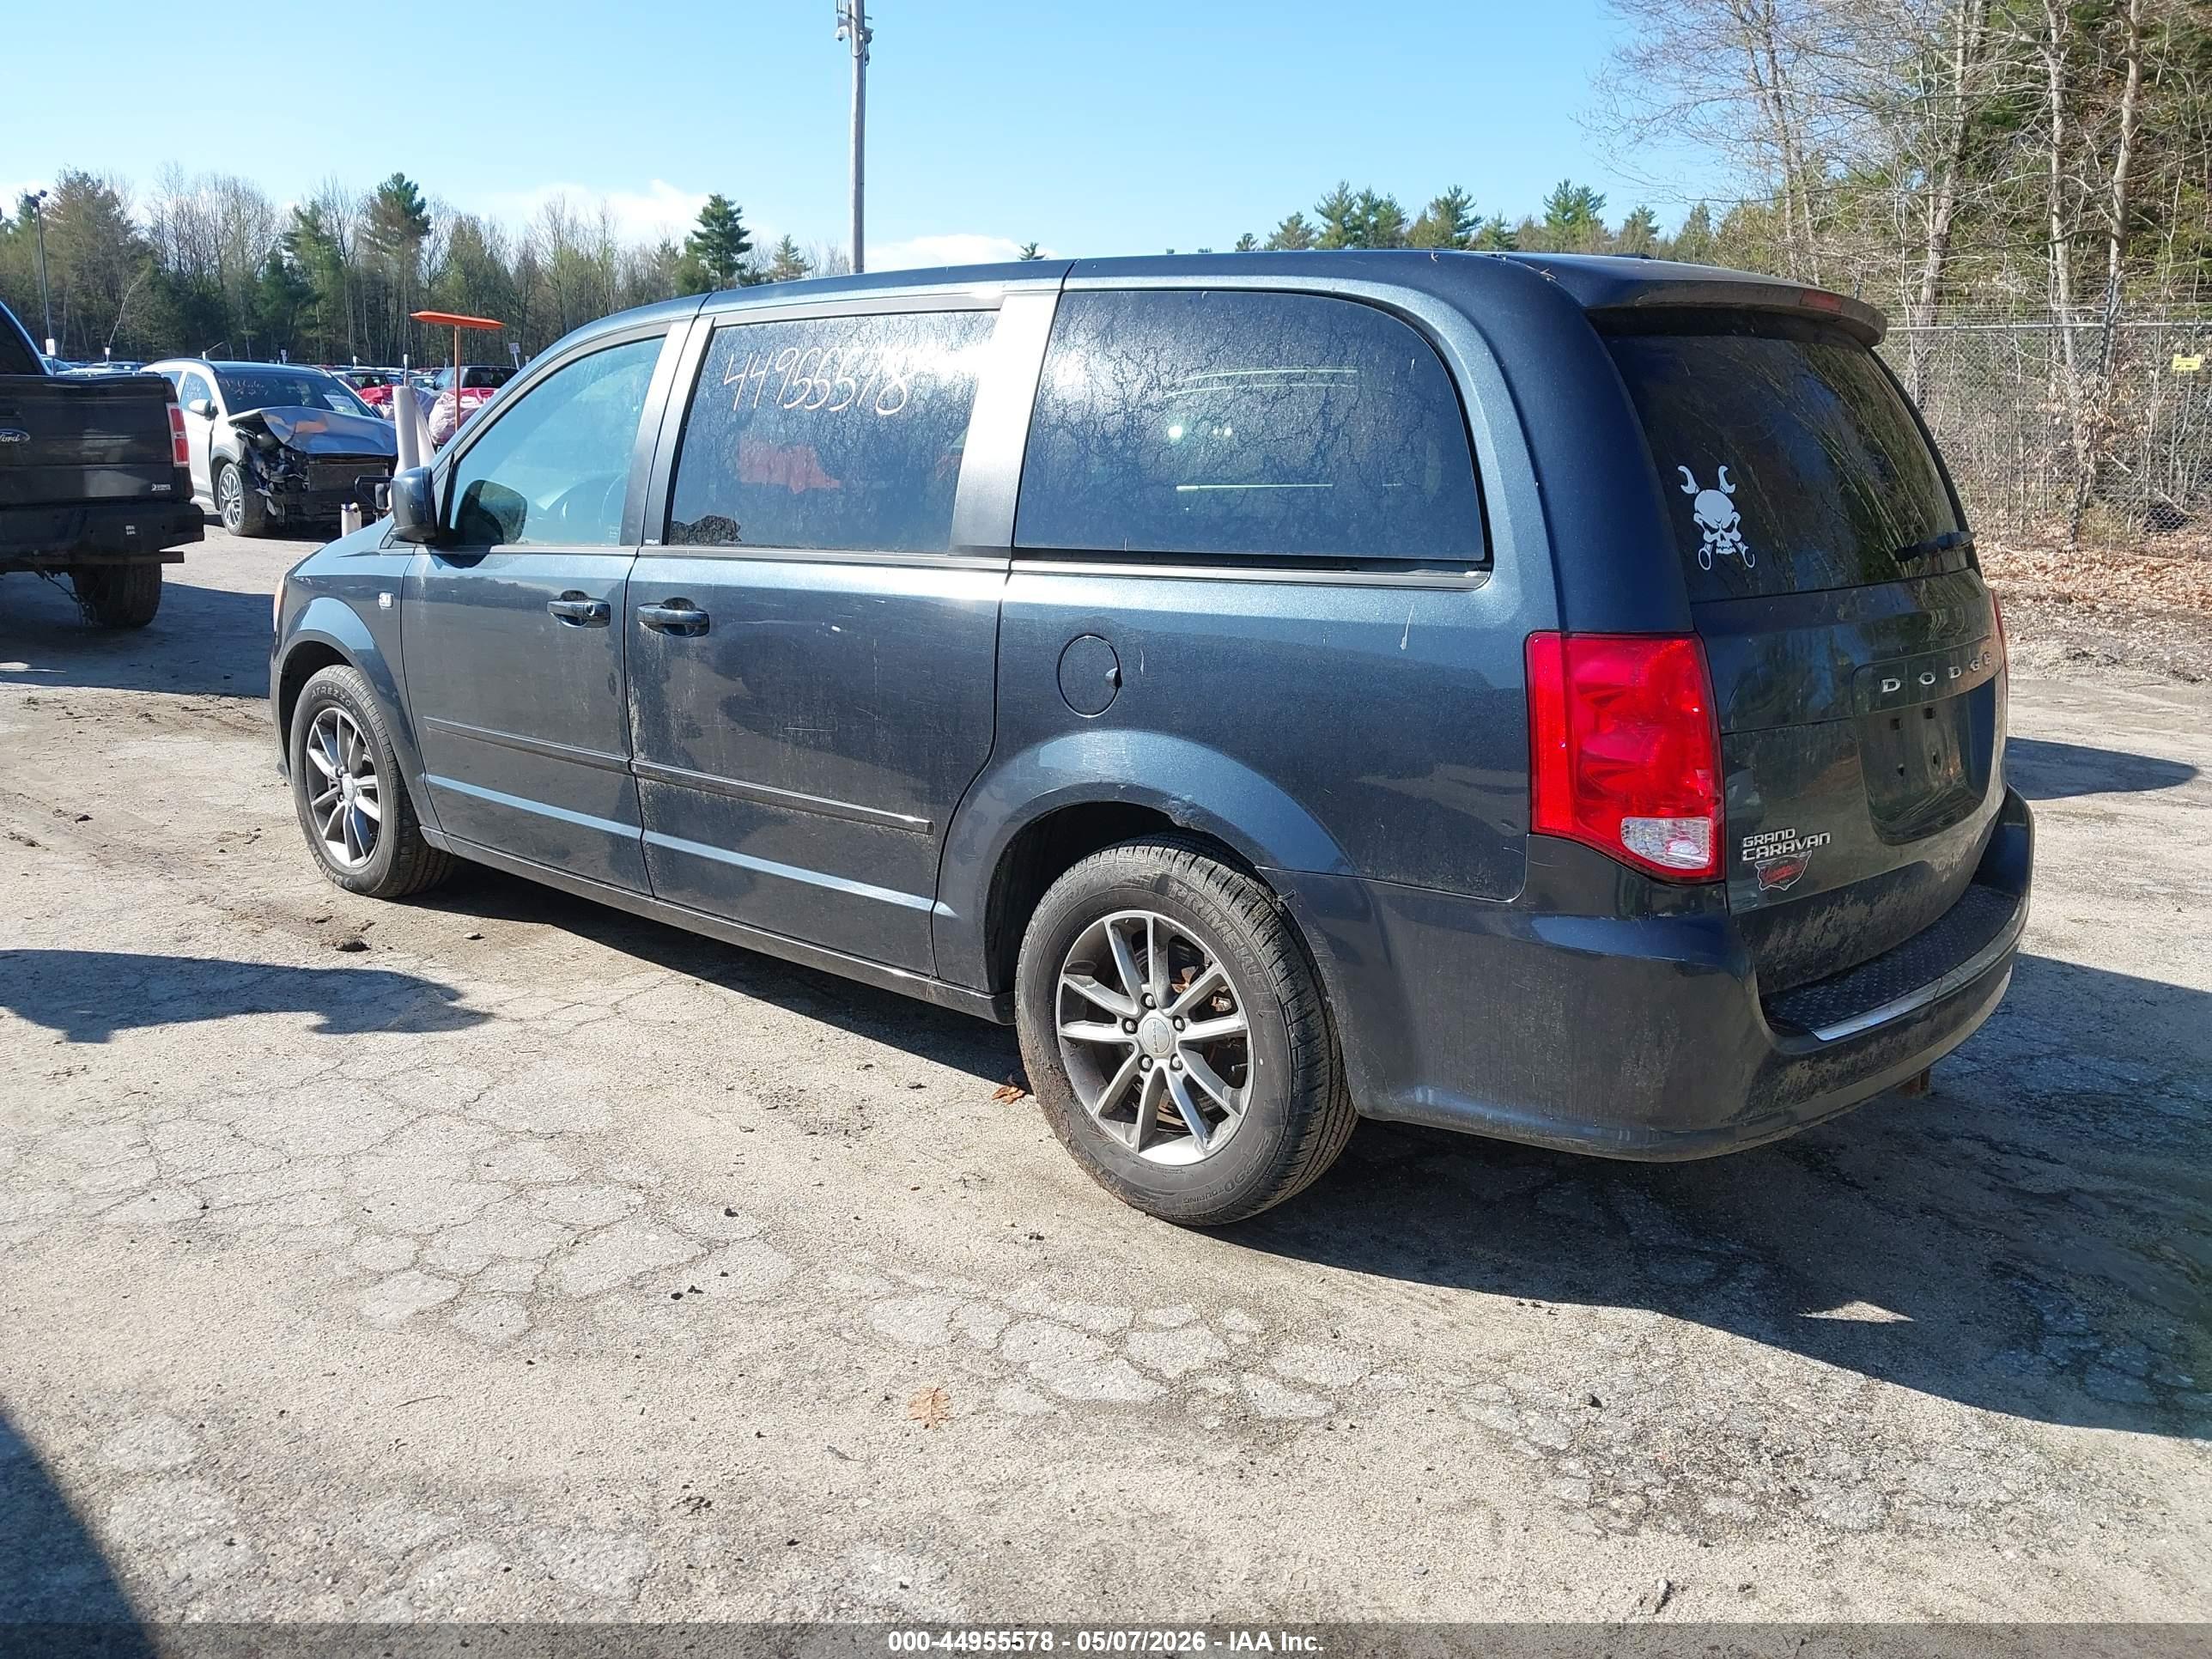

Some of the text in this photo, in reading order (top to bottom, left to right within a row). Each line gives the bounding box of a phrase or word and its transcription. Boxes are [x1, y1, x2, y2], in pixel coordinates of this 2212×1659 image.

[724, 347, 908, 416] 44955578
[1881, 651, 1992, 693] DODGE
[311, 686, 351, 707] ATREZZO
[1742, 828, 1796, 848] GRAND
[1742, 832, 1832, 861] CARAVAN
[1182, 1188, 1224, 1204] TOURING
